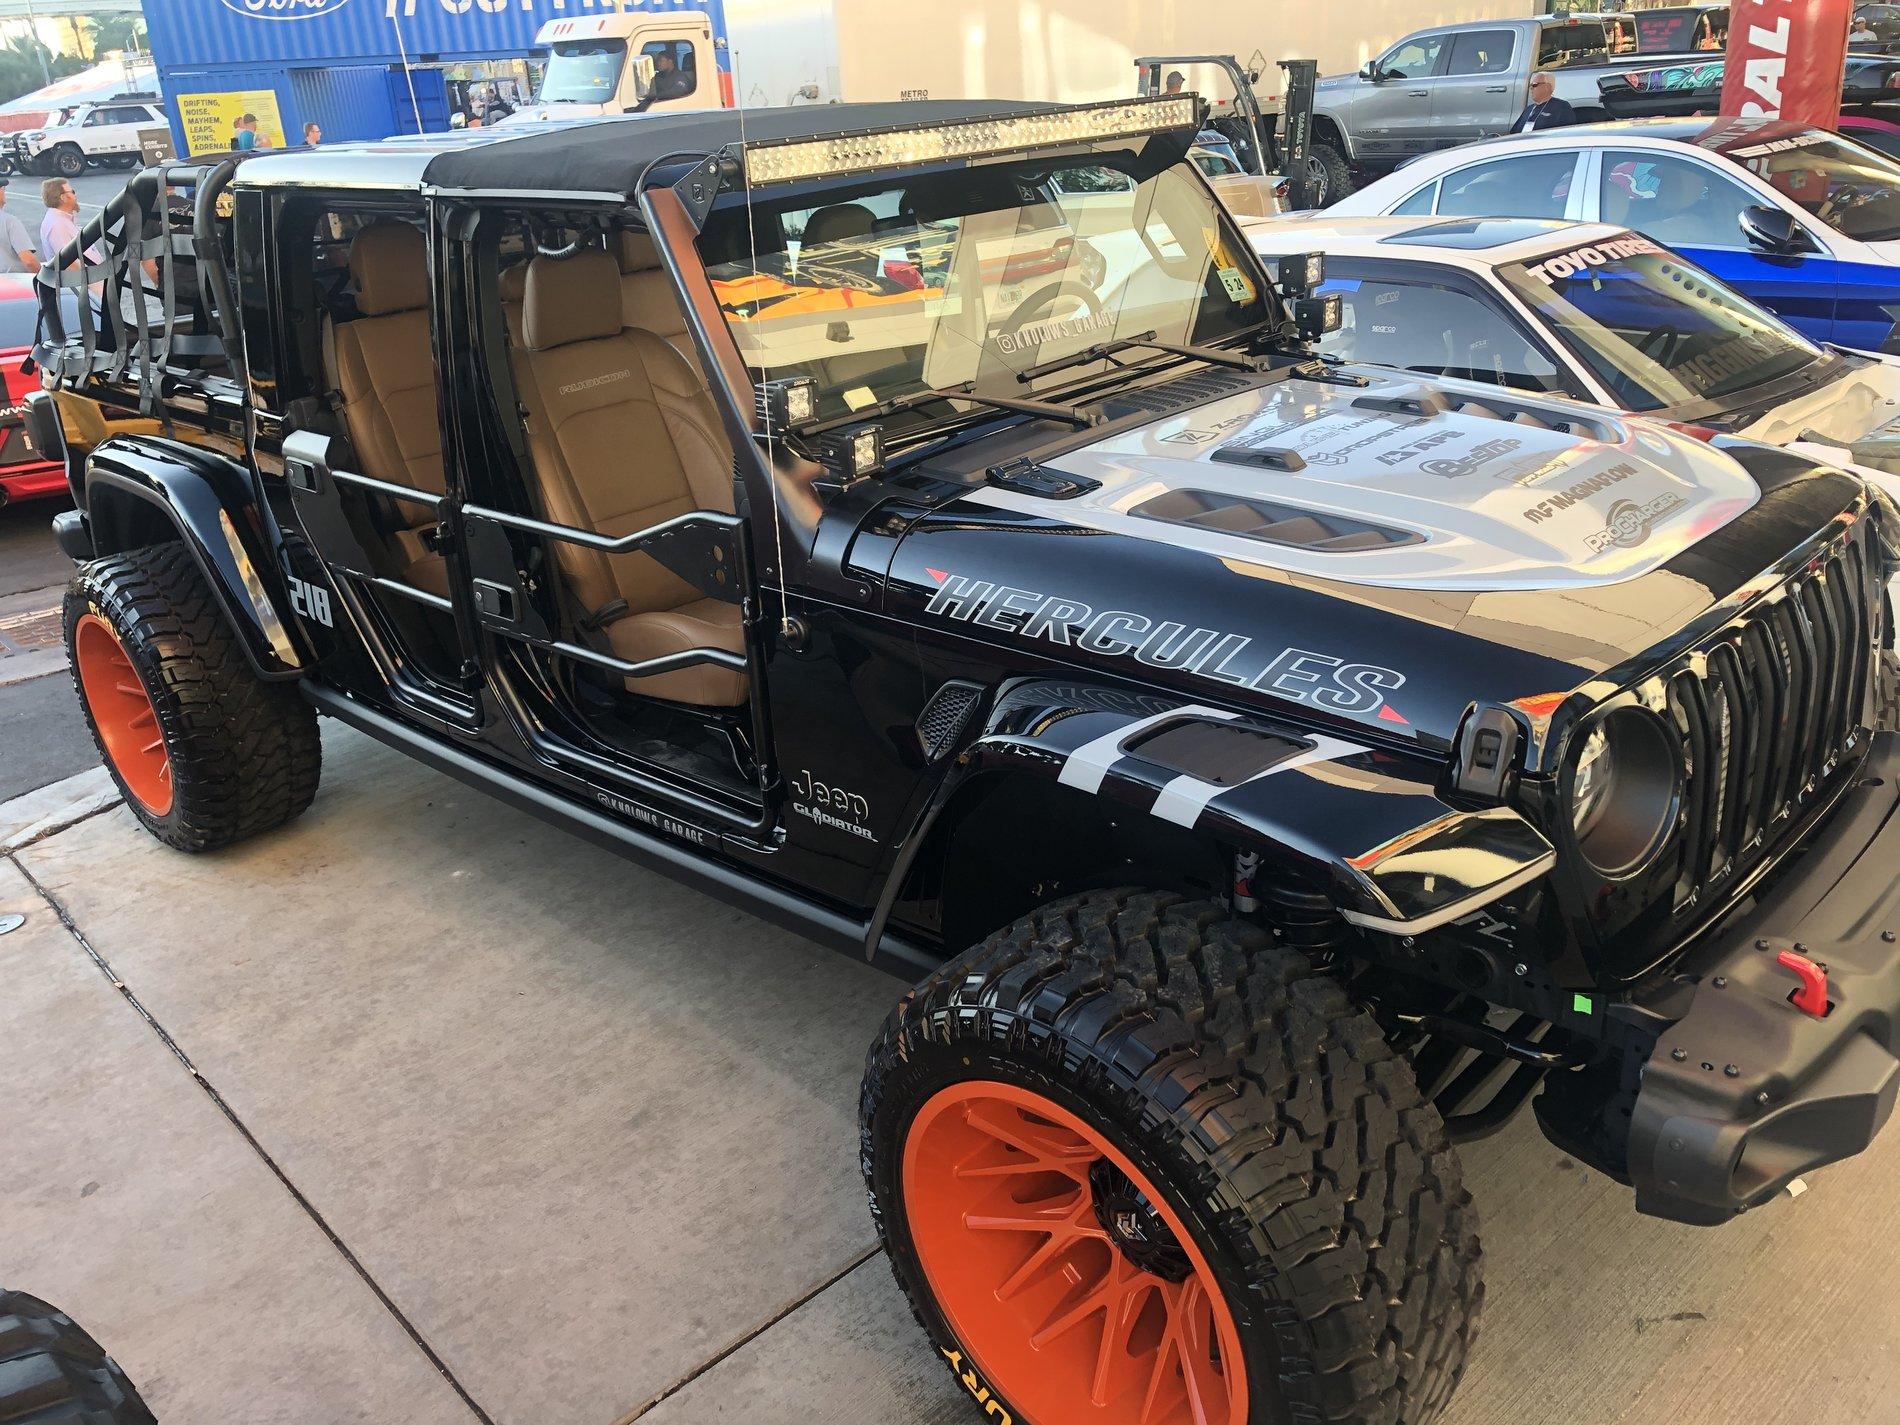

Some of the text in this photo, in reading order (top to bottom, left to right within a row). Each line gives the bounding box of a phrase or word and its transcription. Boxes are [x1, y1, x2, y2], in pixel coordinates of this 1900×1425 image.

[900, 89, 929, 98] METRO
[183, 99, 221, 108] DRIFTING,
[185, 108, 211, 116] NOISE,
[187, 116, 223, 125] MAYHEM,
[189, 126, 216, 134] LEAPS,
[191, 135, 217, 143] SPINS,
[1525, 247, 1607, 286] TOYO
[1224, 277, 1246, 292] 5 24
[1371, 324, 1397, 334] sparco
[559, 369, 631, 396] RUBICON
[1548, 461, 1640, 511] MAGNAFLOW
[1583, 491, 1682, 554] PROCHARGER
[924, 574, 1406, 713] HERCULES
[791, 769, 869, 825] Jeep
[793, 802, 879, 843] GLADIATOR
